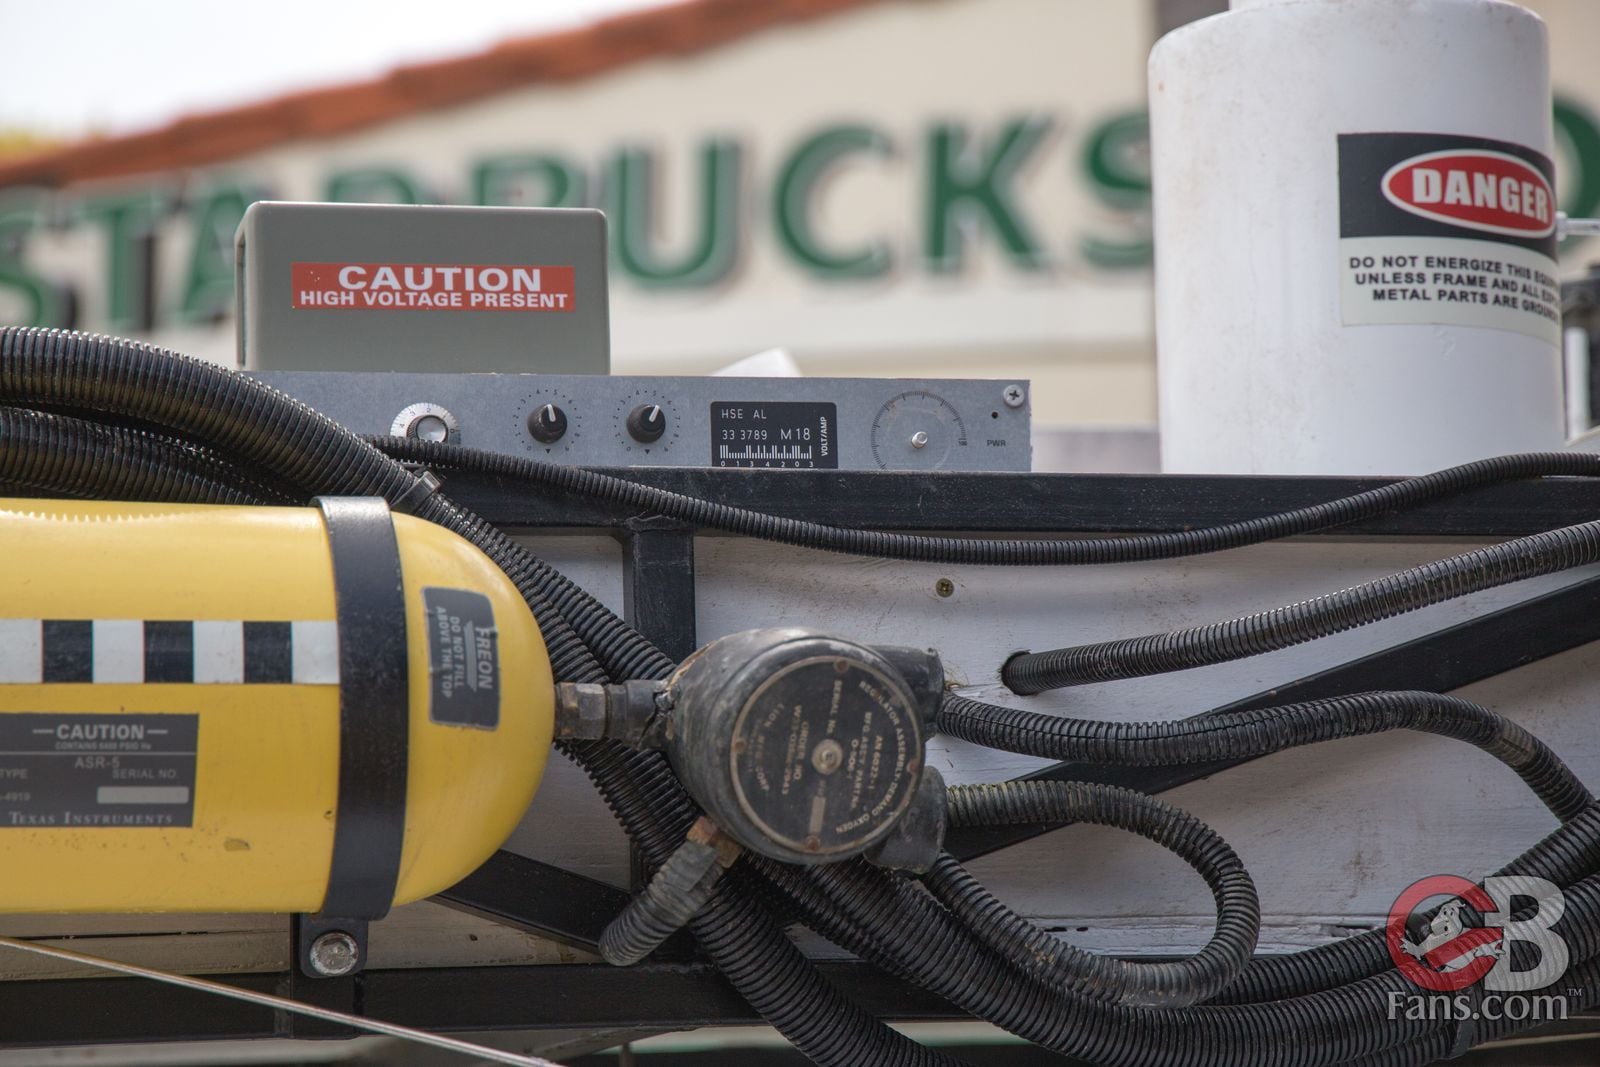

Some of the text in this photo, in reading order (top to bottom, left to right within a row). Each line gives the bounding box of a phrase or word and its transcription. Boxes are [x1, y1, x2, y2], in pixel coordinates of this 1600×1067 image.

[1412, 168, 1549, 224] DANGER
[338, 266, 541, 292] CAUTION
[1350, 257, 1375, 269] DO
[1383, 256, 1418, 268] NOT
[1426, 257, 1502, 274] ENERGIZE
[1507, 264, 1531, 280] THIS
[1356, 273, 1426, 285] UNLESS
[1434, 273, 1487, 288] FRAME
[1492, 278, 1518, 293] AND
[1521, 284, 1539, 298] ALL
[301, 291, 568, 308] HIGH VOLTAGE PRESENT
[1373, 289, 1431, 301] METAL
[1438, 290, 1488, 304] PARTS
[1493, 294, 1518, 309] ARE
[721, 408, 767, 419] HSE AL
[820, 416, 828, 456] VOLT/AMP
[436, 606, 453, 698] ABOVE THE TOP
[450, 616, 464, 688] DO NOT FILL
[475, 626, 493, 689] FREON
[56, 724, 144, 739] CAUTION
[74, 757, 120, 769] ASR-5
[112, 769, 154, 779] SERIAL
